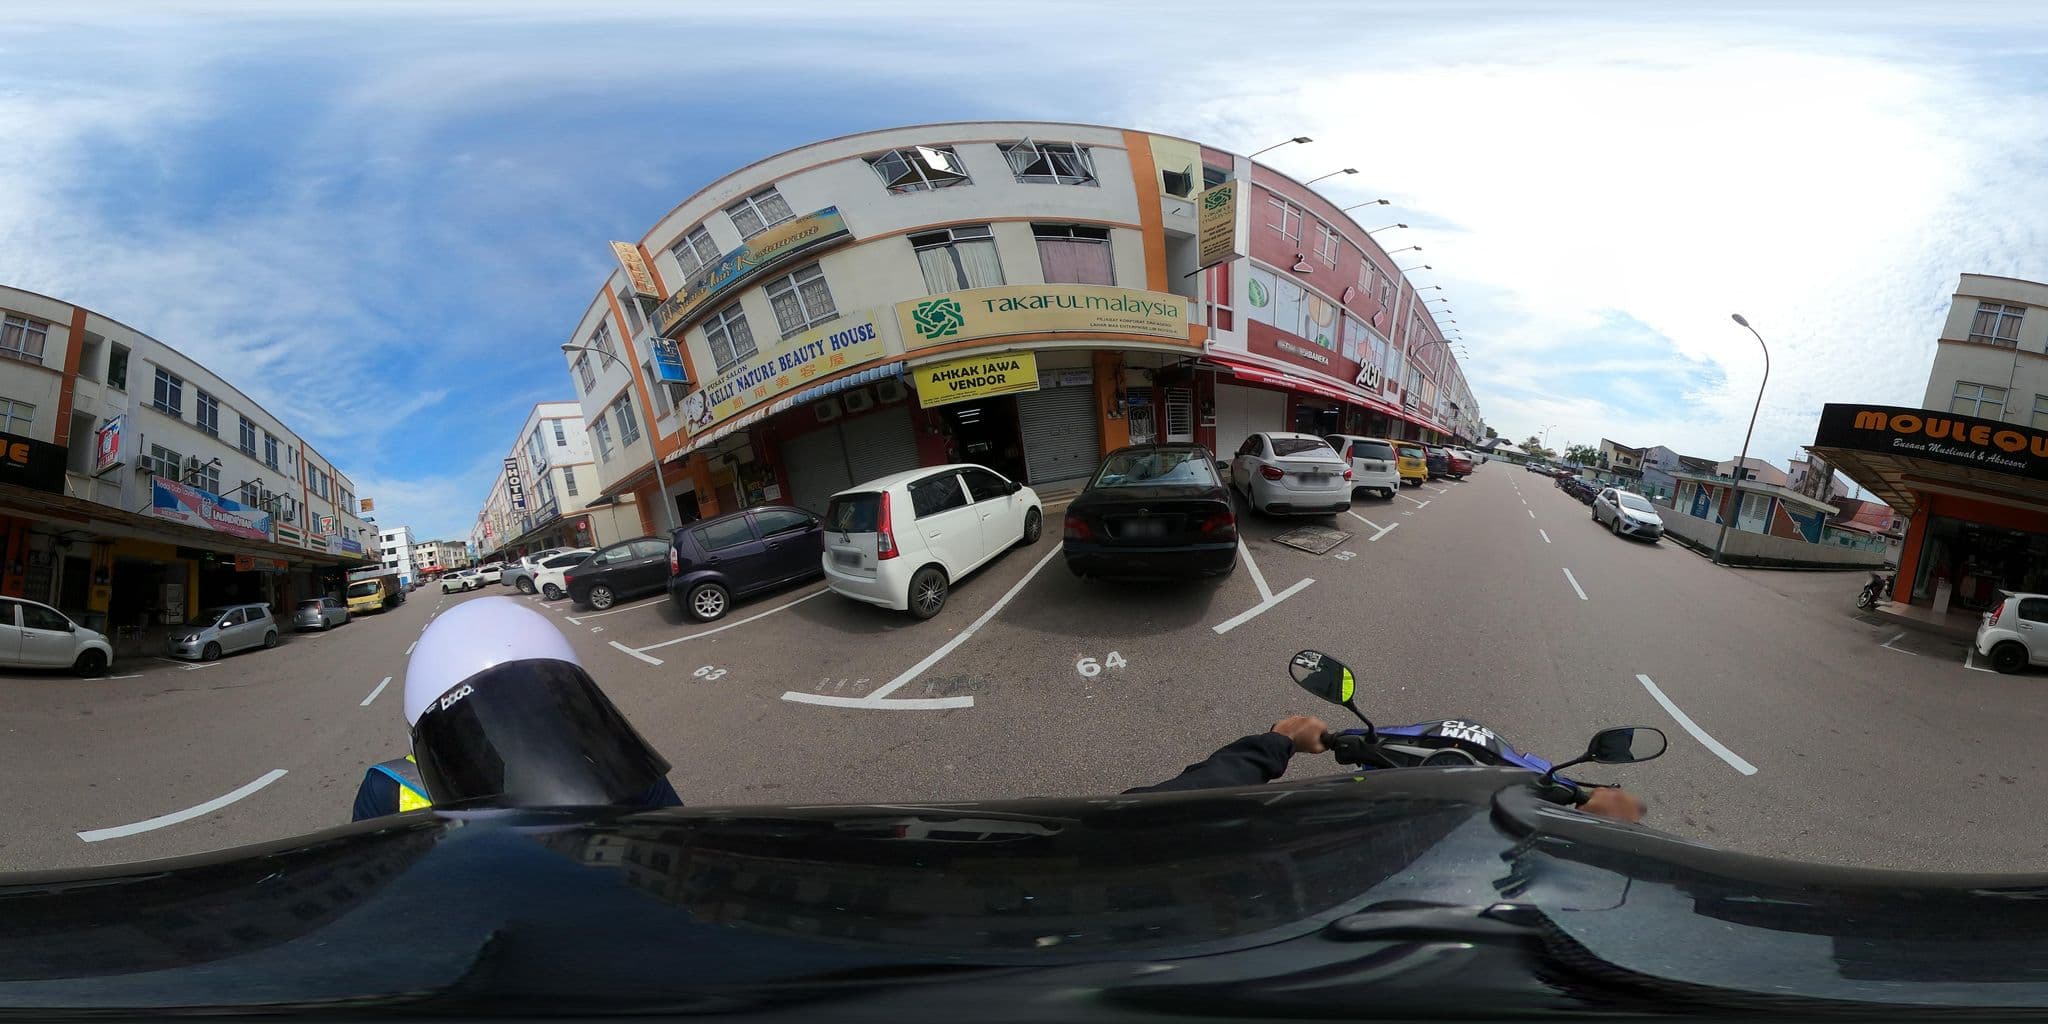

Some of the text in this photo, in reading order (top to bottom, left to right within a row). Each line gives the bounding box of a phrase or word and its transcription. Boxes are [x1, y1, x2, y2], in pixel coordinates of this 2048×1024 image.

[709, 323, 876, 408] KELLY NATURE BEAUTY HOUSE
[932, 361, 1020, 383] AHKAK JAWA
[707, 364, 748, 393] PUSAT SALON
[949, 374, 1006, 391] VENDOR
[1892, 438, 1925, 451] Busana
[1928, 443, 1975, 460] Muslimah
[1977, 451, 1985, 461] &
[506, 468, 526, 511] HOTEL
[694, 665, 727, 680] 63
[1076, 651, 1127, 677] 64
[1440, 727, 1487, 746] WYM
